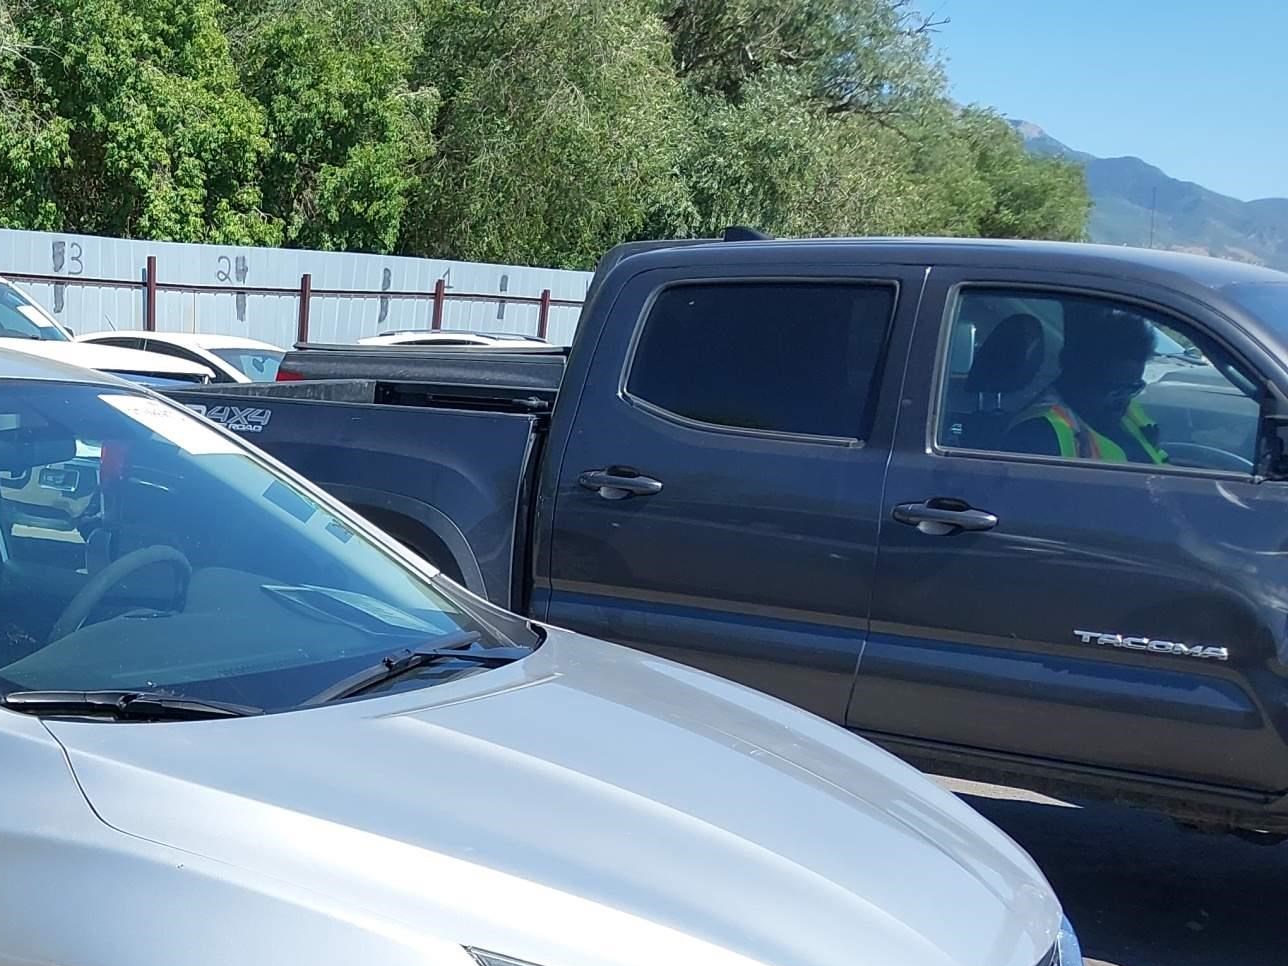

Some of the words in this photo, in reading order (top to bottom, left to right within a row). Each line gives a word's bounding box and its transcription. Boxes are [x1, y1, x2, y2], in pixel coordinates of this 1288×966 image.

[207, 405, 272, 426] 4X4
[227, 423, 263, 432] ROAD
[1073, 629, 1229, 661] TACOMA
